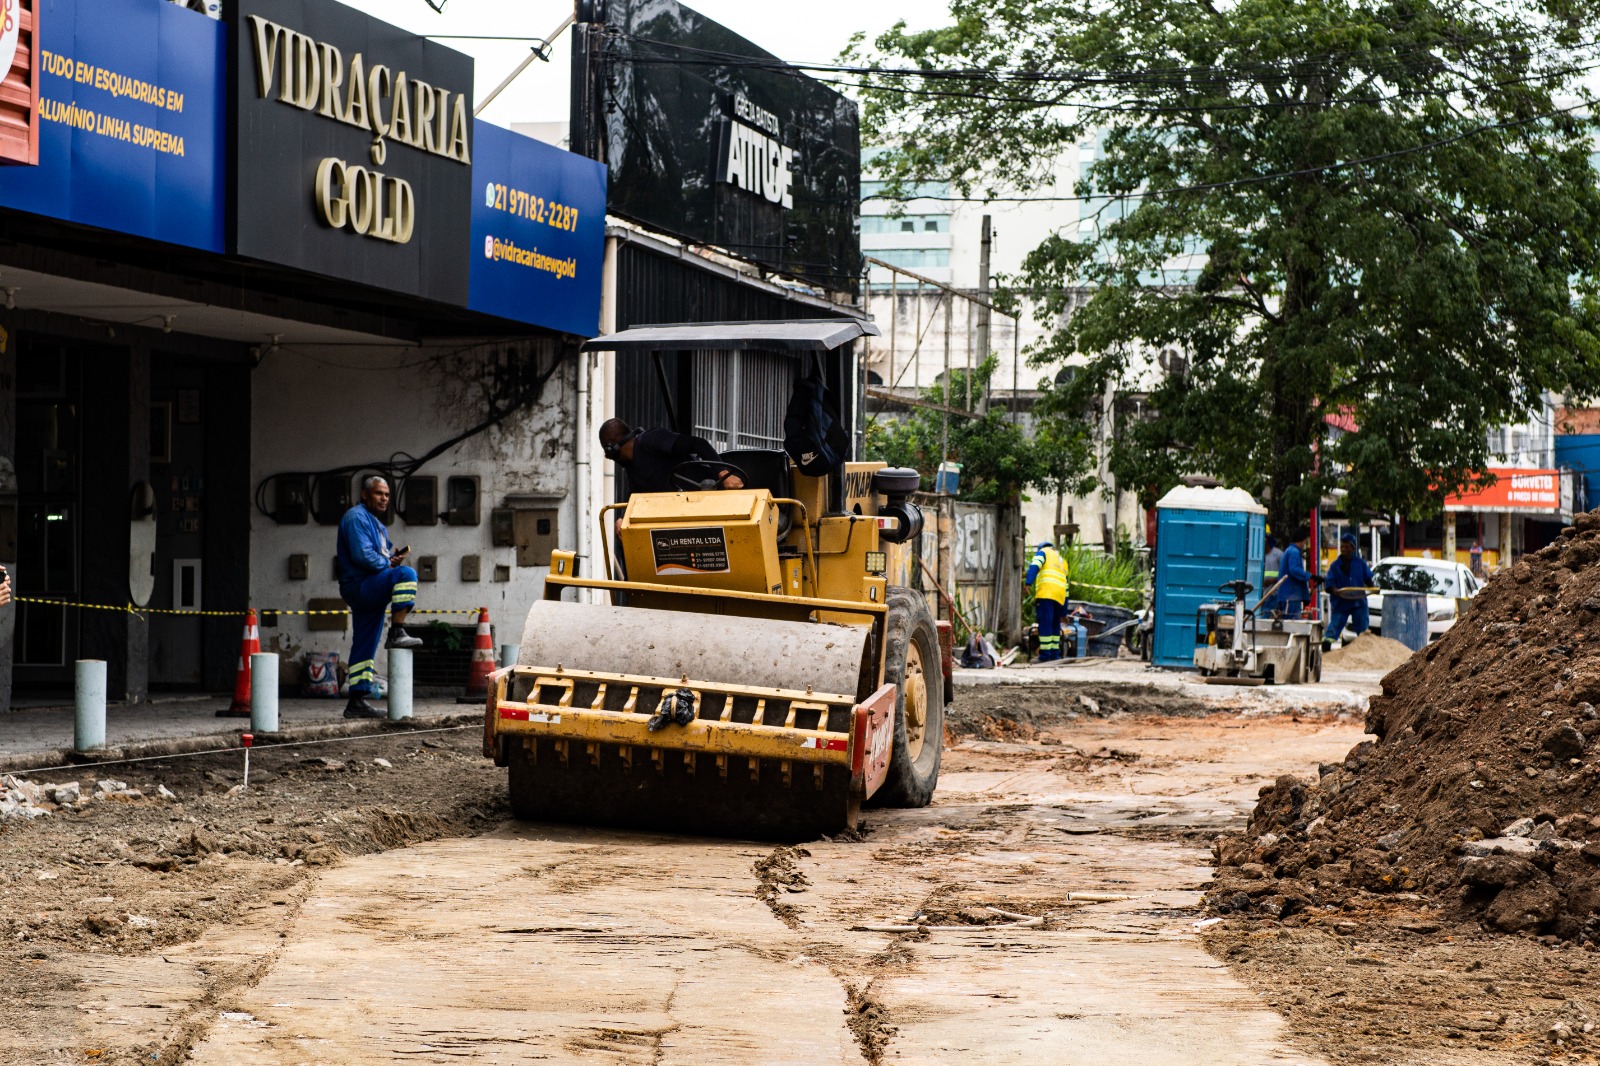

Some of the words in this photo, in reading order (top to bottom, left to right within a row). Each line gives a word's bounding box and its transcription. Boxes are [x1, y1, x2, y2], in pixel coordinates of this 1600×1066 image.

[41, 50, 74, 79] TUDO
[75, 61, 94, 86] EM
[95, 67, 165, 107] ESQUADRIAS
[166, 90, 184, 113] EM
[246, 14, 471, 165] VIDRAÇARIA
[38, 97, 95, 132] ALUMÍNIO
[96, 113, 131, 142] LINHA
[132, 124, 185, 157] SUPREMA
[756, 105, 780, 137] BATISTA
[726, 120, 793, 210] ATITUDE
[315, 157, 415, 244] GOLD
[494, 183, 507, 211] 21
[509, 188, 578, 232] 97182-2287
[493, 237, 576, 280] @vidracarianewgold
[679, 537, 704, 545] RENTAL
